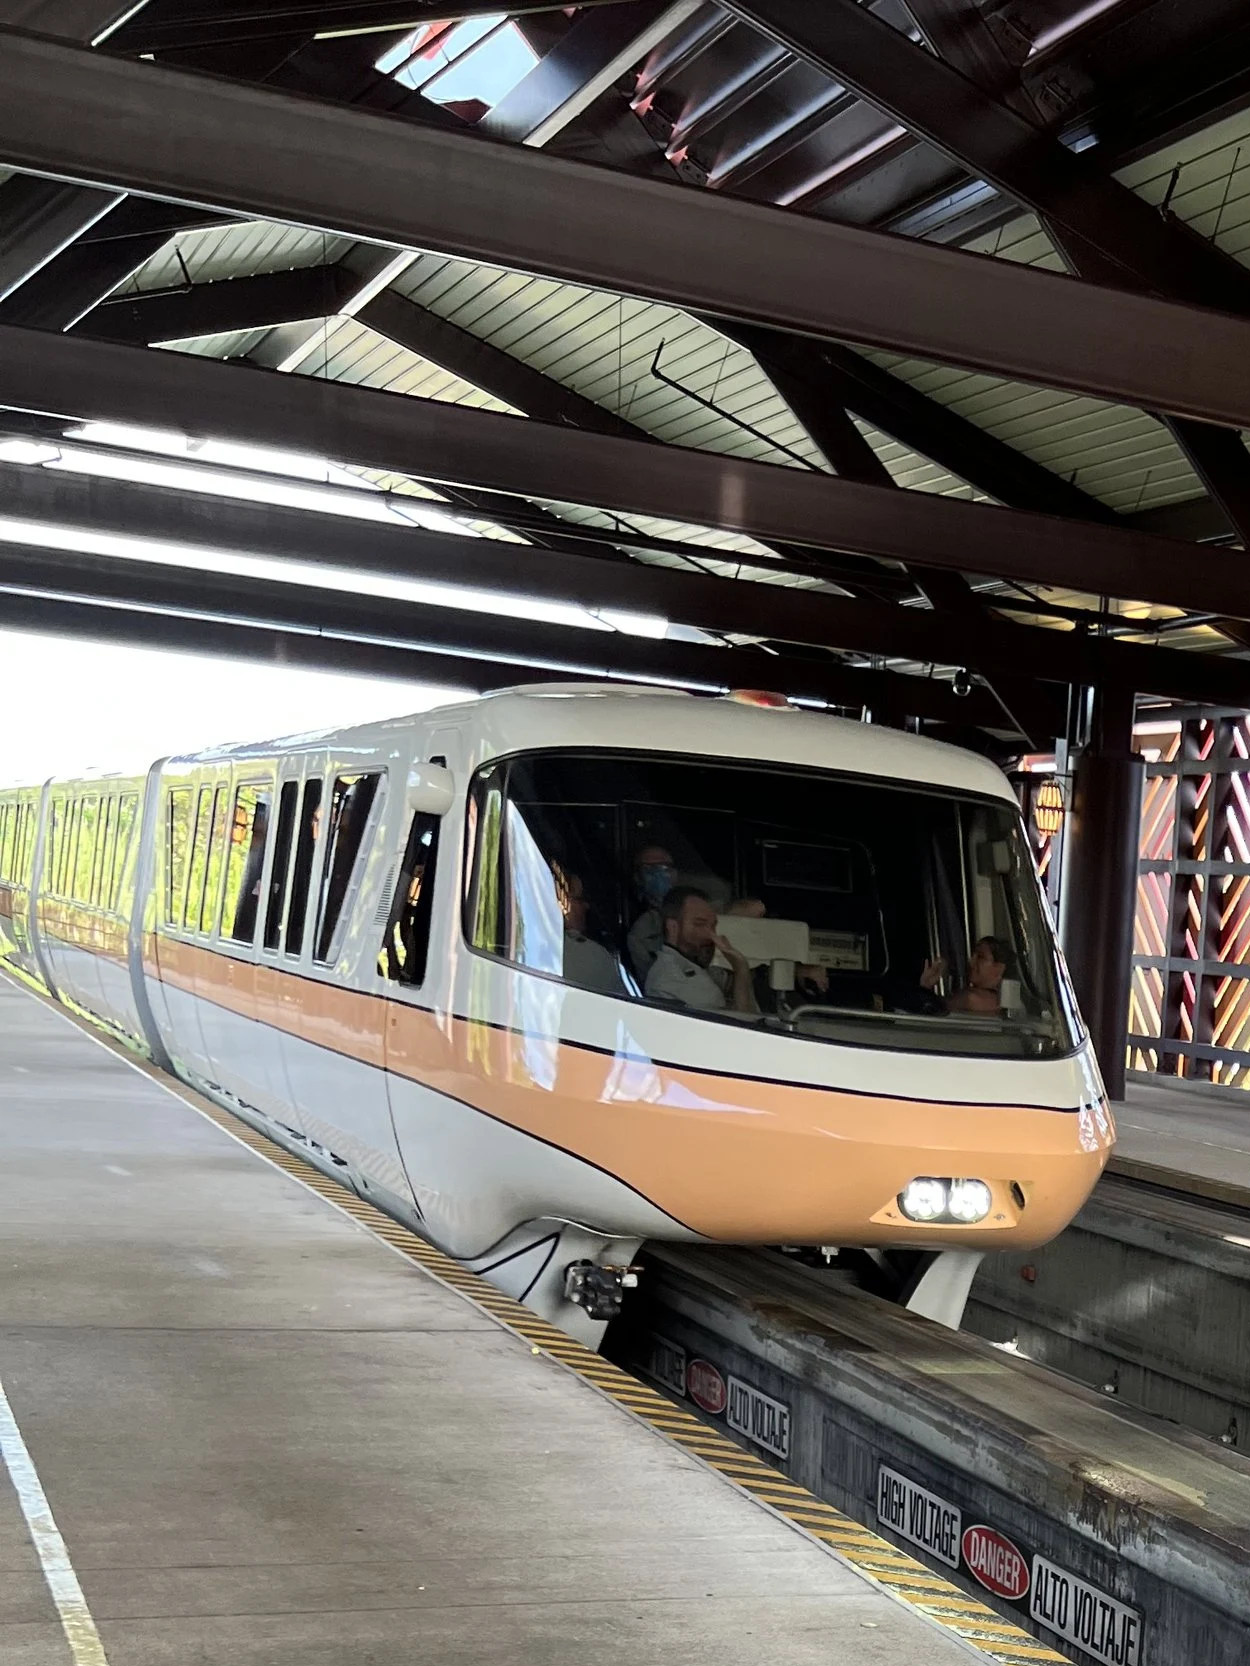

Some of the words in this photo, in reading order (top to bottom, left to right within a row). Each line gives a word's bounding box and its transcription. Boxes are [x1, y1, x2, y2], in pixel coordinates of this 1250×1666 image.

[727, 1381, 750, 1431] ALTO
[751, 1393, 788, 1454] VOLTAJE
[880, 1472, 907, 1530] HIGH
[908, 1488, 959, 1563] VOLTAGE
[970, 1530, 1021, 1594] DANGER
[1032, 1563, 1070, 1630] ALTO
